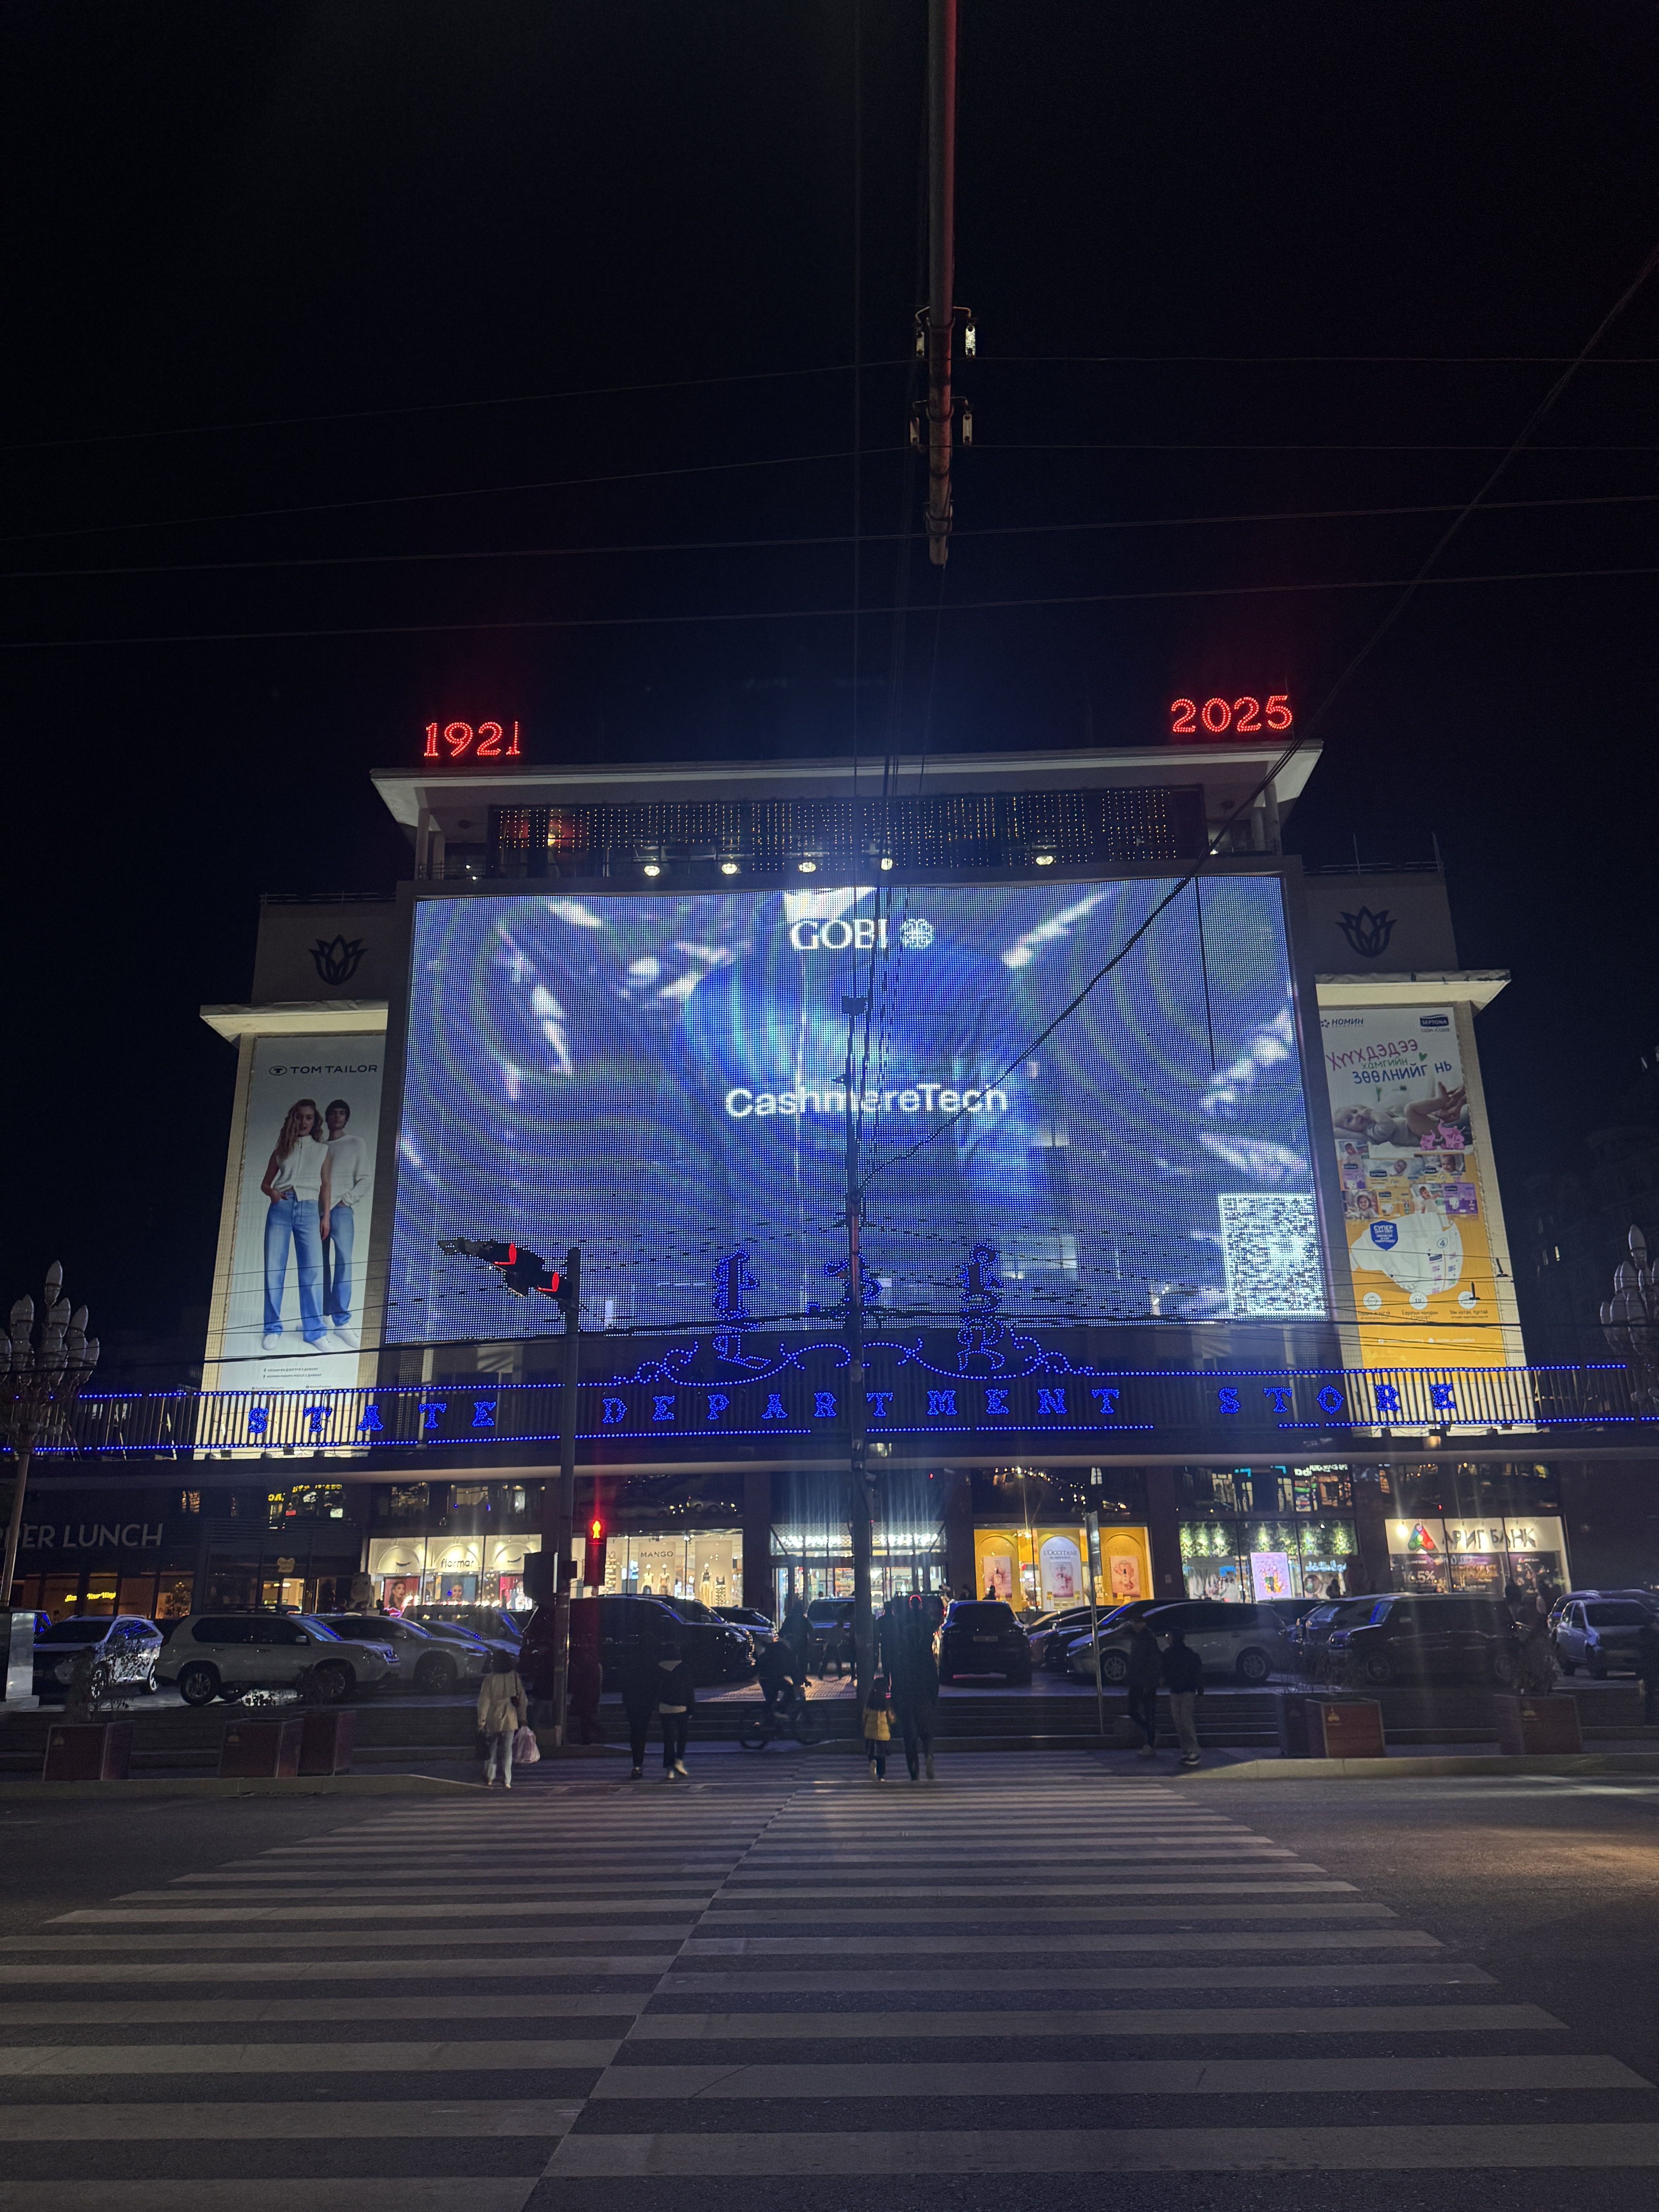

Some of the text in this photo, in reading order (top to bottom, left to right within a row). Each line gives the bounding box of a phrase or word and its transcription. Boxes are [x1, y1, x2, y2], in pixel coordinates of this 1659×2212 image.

[1170, 694, 1293, 733] 2025
[424, 721, 521, 757] 1921
[791, 918, 888, 950] GOBI
[325, 1065, 378, 1073] TAILOR
[1362, 1058, 1408, 1070] хамгийн
[1435, 1061, 1452, 1073] НЬ
[725, 1083, 1008, 1118] CashmereTech
[248, 1383, 1456, 1434] STATE DEPARTMENT STORE
[63, 1523, 163, 1548] LUNCH
[1442, 1527, 1537, 1550] АРИГ БАНК
[441, 1558, 474, 1568] flormar
